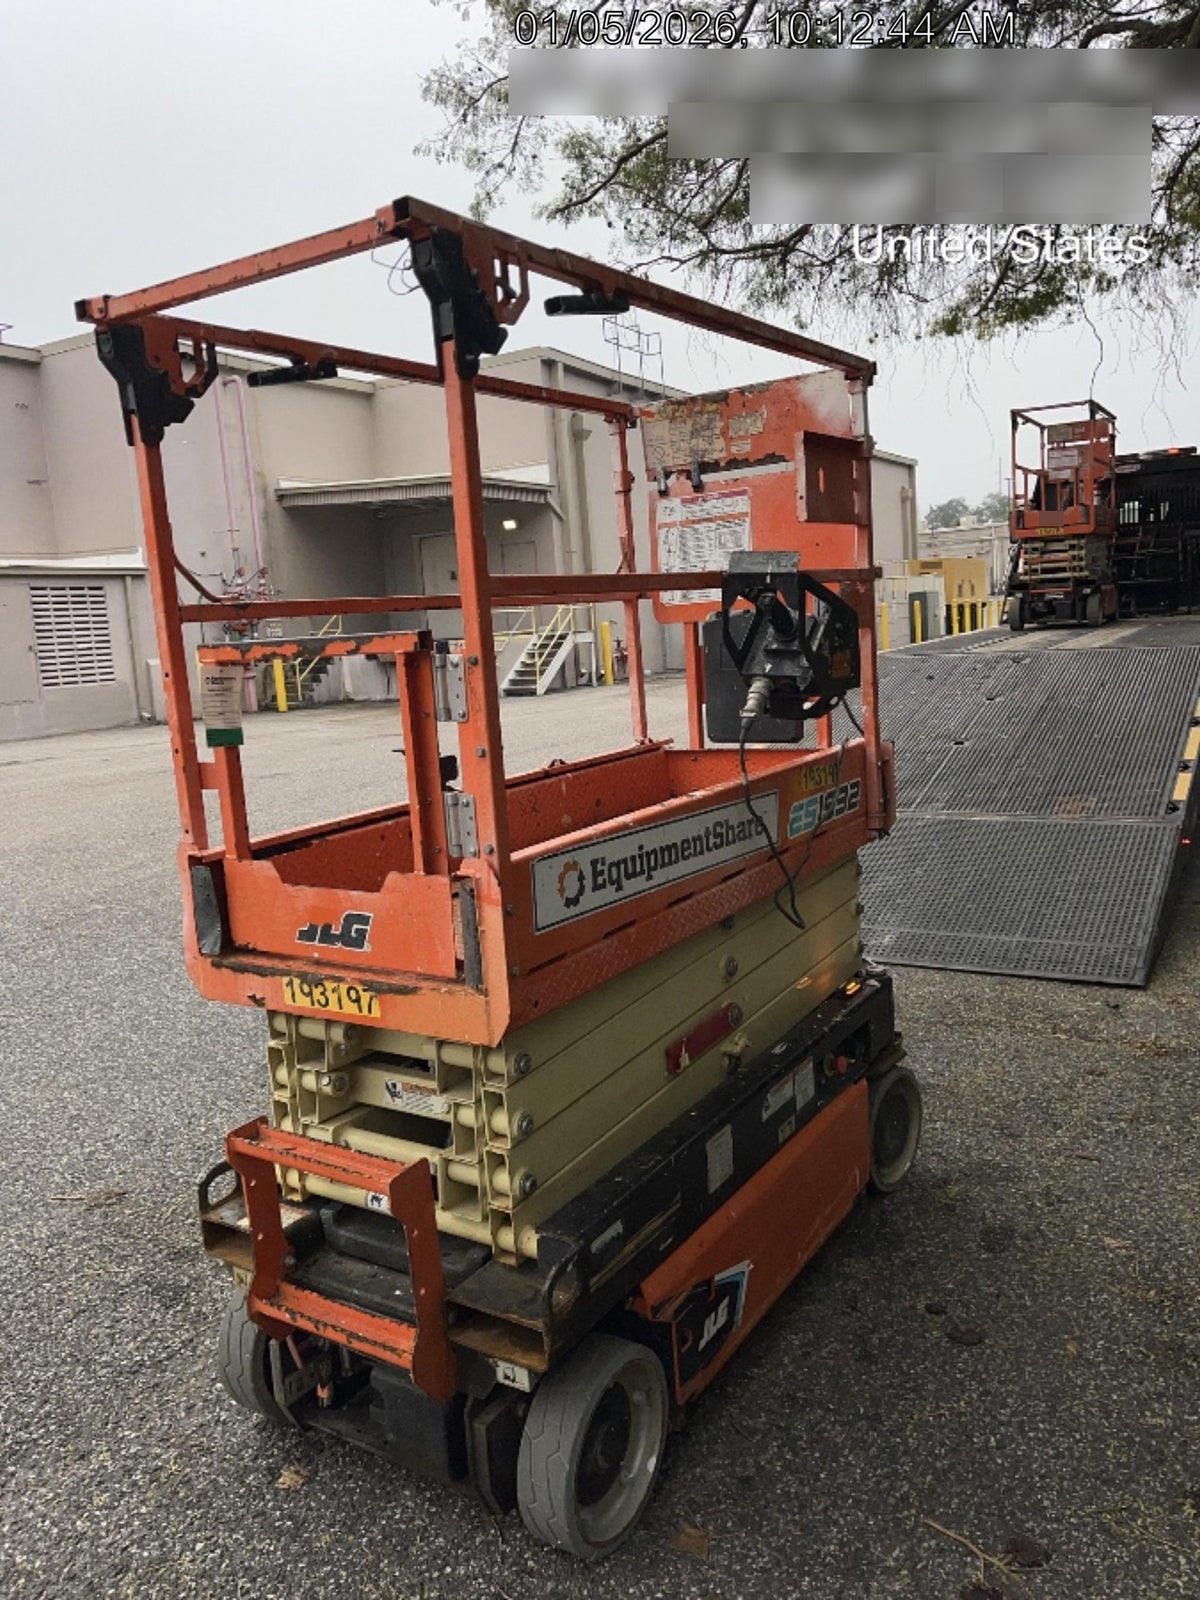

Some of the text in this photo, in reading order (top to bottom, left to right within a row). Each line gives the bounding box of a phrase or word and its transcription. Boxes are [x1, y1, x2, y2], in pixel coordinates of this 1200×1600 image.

[589, 815, 765, 893] EquipmentShare
[295, 908, 374, 953] JLG
[285, 977, 377, 1015] 193197
[698, 1296, 730, 1352] JLG
